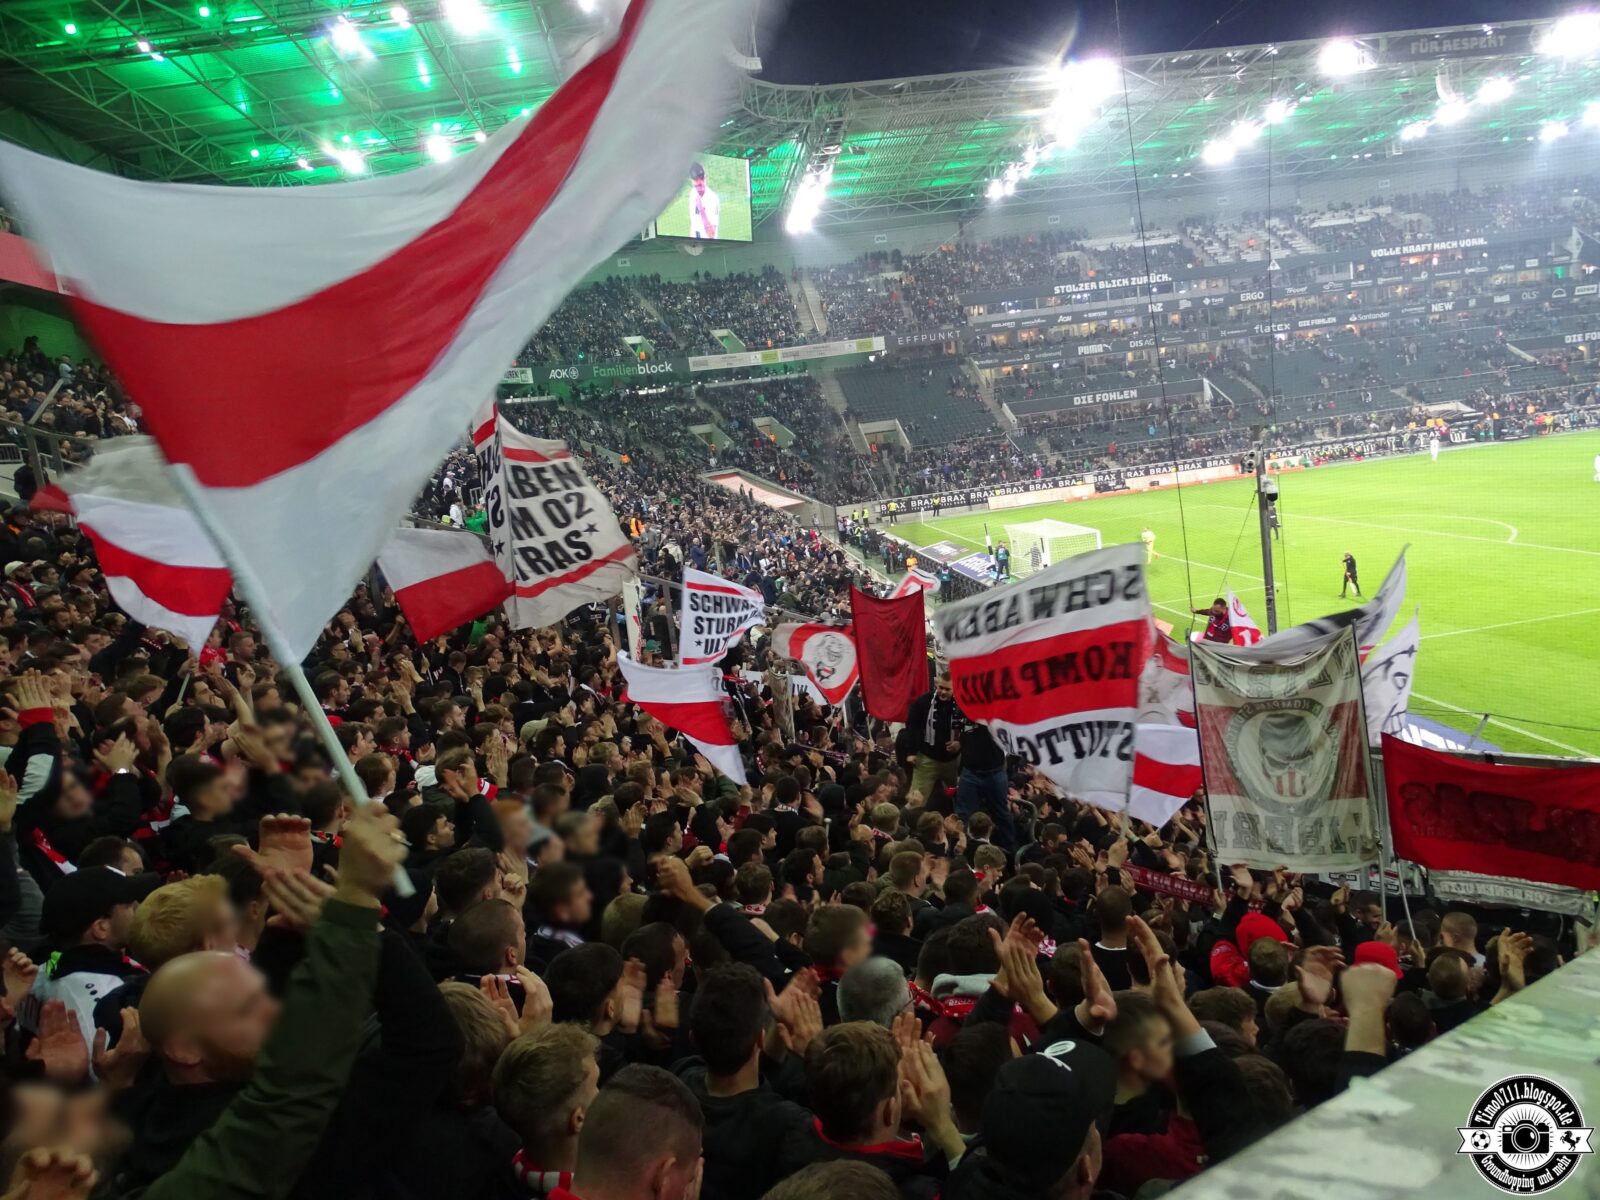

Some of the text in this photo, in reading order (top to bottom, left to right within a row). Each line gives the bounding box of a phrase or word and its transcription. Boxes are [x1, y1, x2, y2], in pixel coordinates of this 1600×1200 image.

[1371, 237, 1488, 257] VOLLE KRAFT NACH VORN.
[1054, 273, 1172, 294] STOLZER BLICK ZURÜCK.
[1240, 292, 1264, 301] ERGO
[1431, 302, 1453, 312] NEW
[1357, 312, 1390, 320] Santander
[1254, 322, 1290, 333] flatex
[897, 330, 961, 345] EFFPUNKT
[1078, 344, 1103, 355] PUMA
[550, 369, 569, 379] AOK
[593, 361, 672, 377] Familienblock
[1073, 389, 1137, 405] DIE FOHLEN
[1150, 466, 1173, 475] BRAX
[1178, 462, 1202, 471] BRAX
[1207, 458, 1230, 468] BRAX
[881, 502, 905, 511] BAX
[941, 493, 965, 503] BRAX
[970, 490, 994, 499] BRAX
[1029, 482, 1053, 491] BRAX
[1059, 478, 1079, 487] BRA
[542, 492, 594, 529] 02
